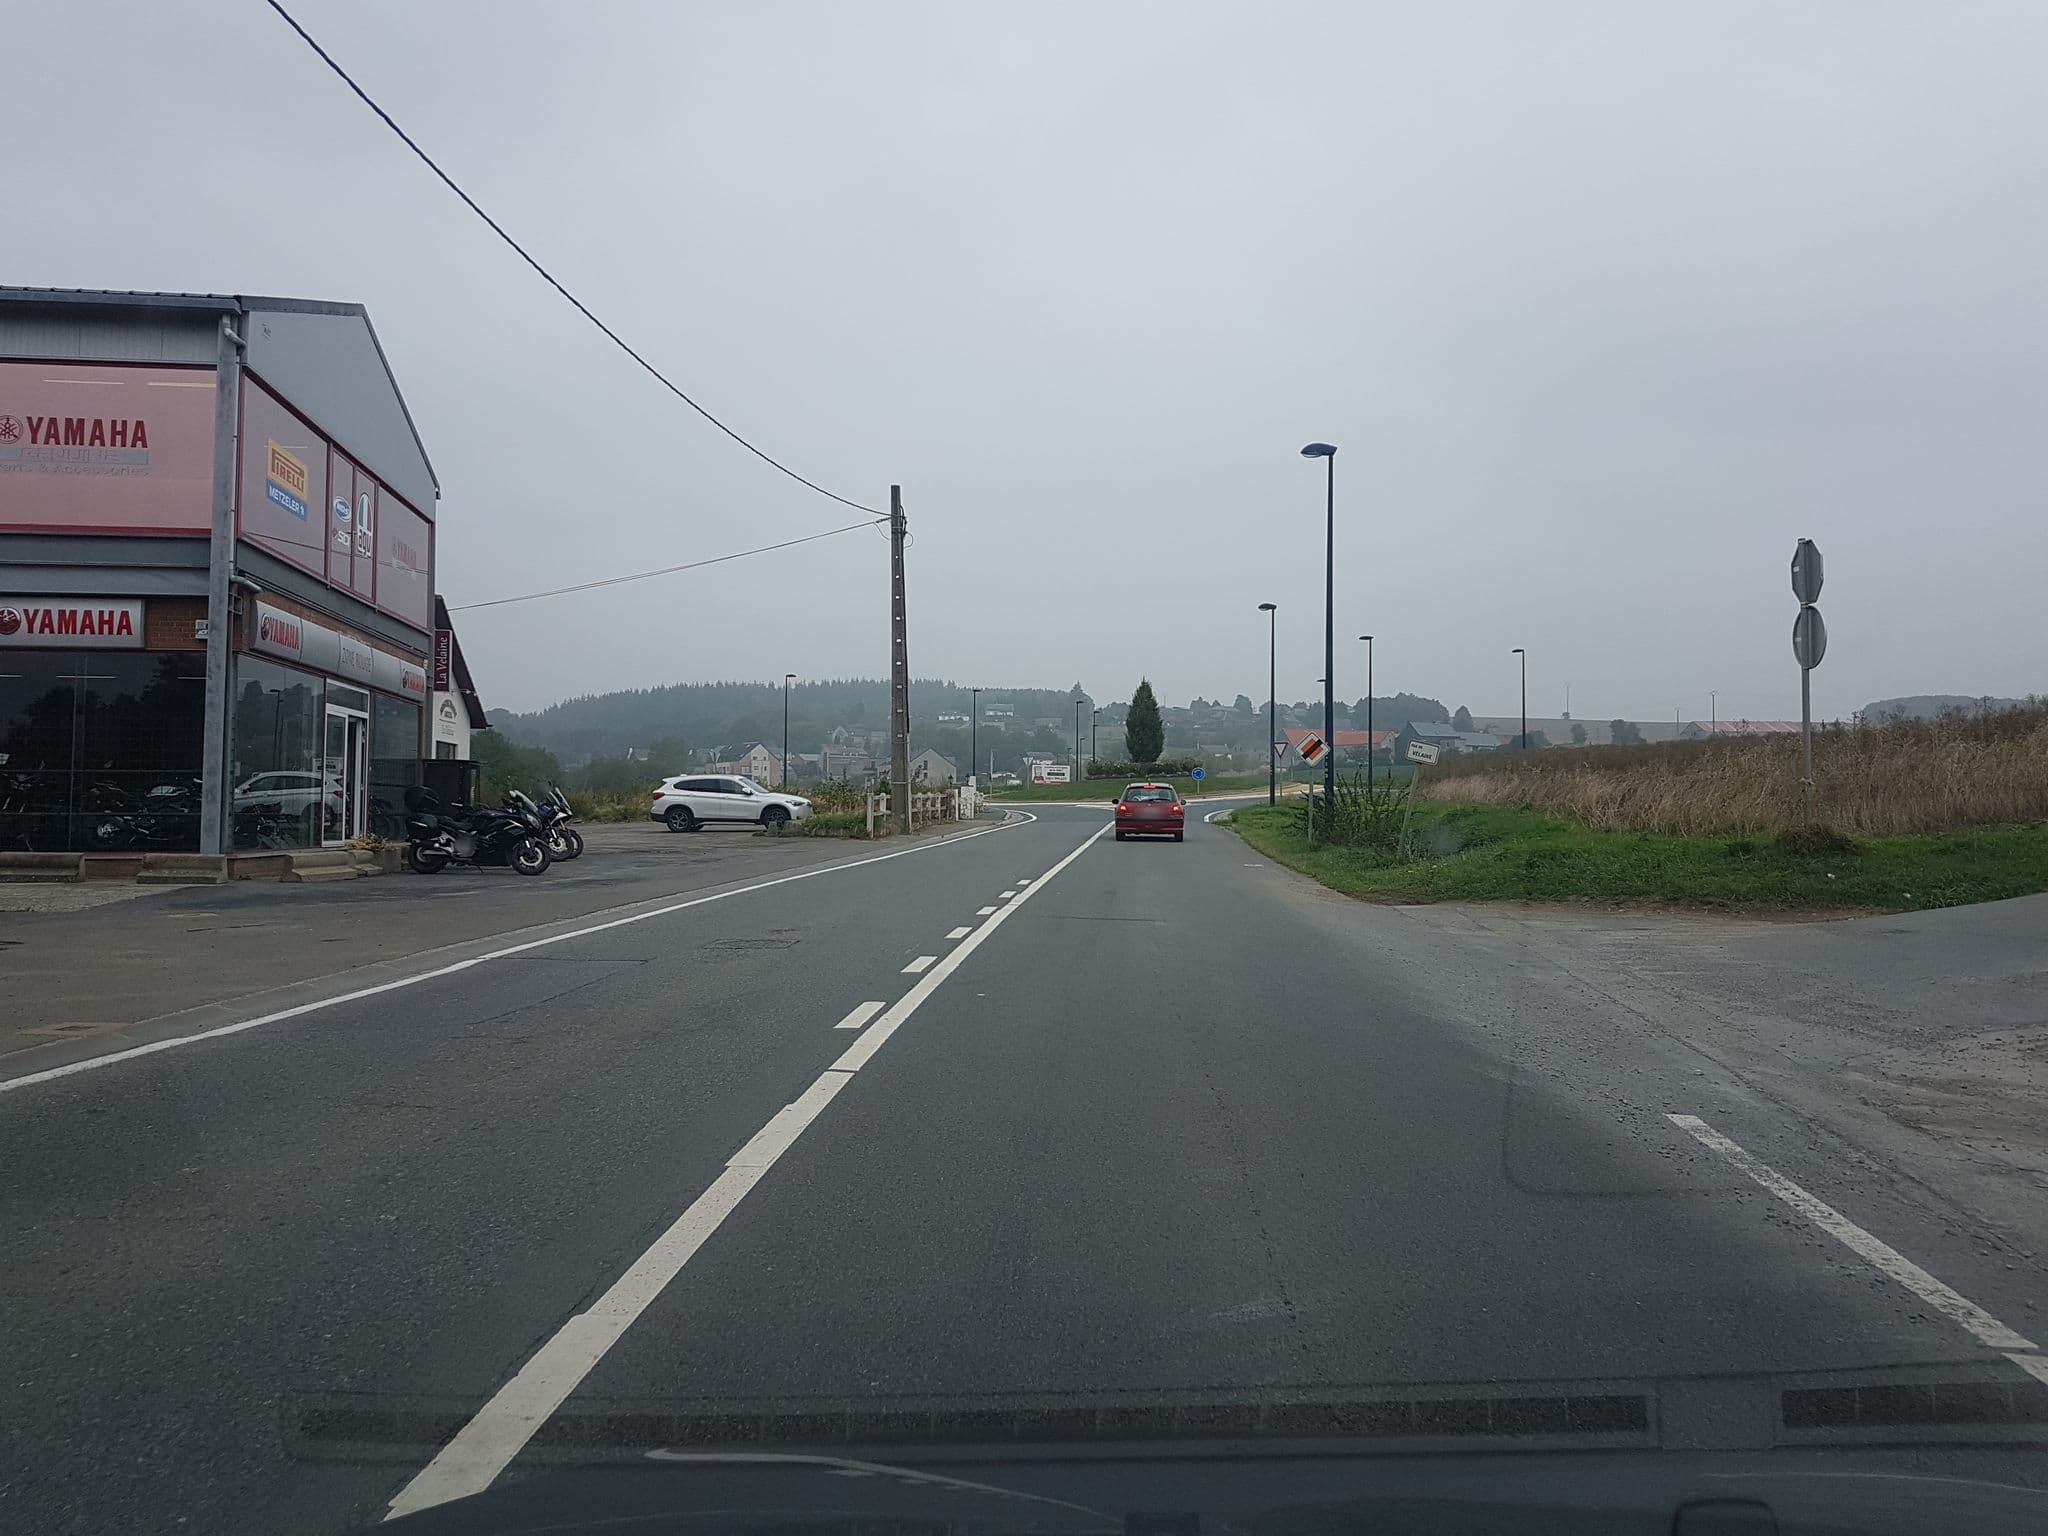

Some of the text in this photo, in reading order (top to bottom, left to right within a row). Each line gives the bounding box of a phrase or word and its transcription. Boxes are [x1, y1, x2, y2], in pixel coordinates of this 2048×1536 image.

[26, 416, 148, 448] YAMAHA
[271, 448, 305, 493] PIRELLI
[269, 485, 300, 514] METZELER
[23, 609, 133, 635] YAMAHA
[271, 616, 299, 650] YAMAHA
[436, 637, 448, 684] La Velaine
